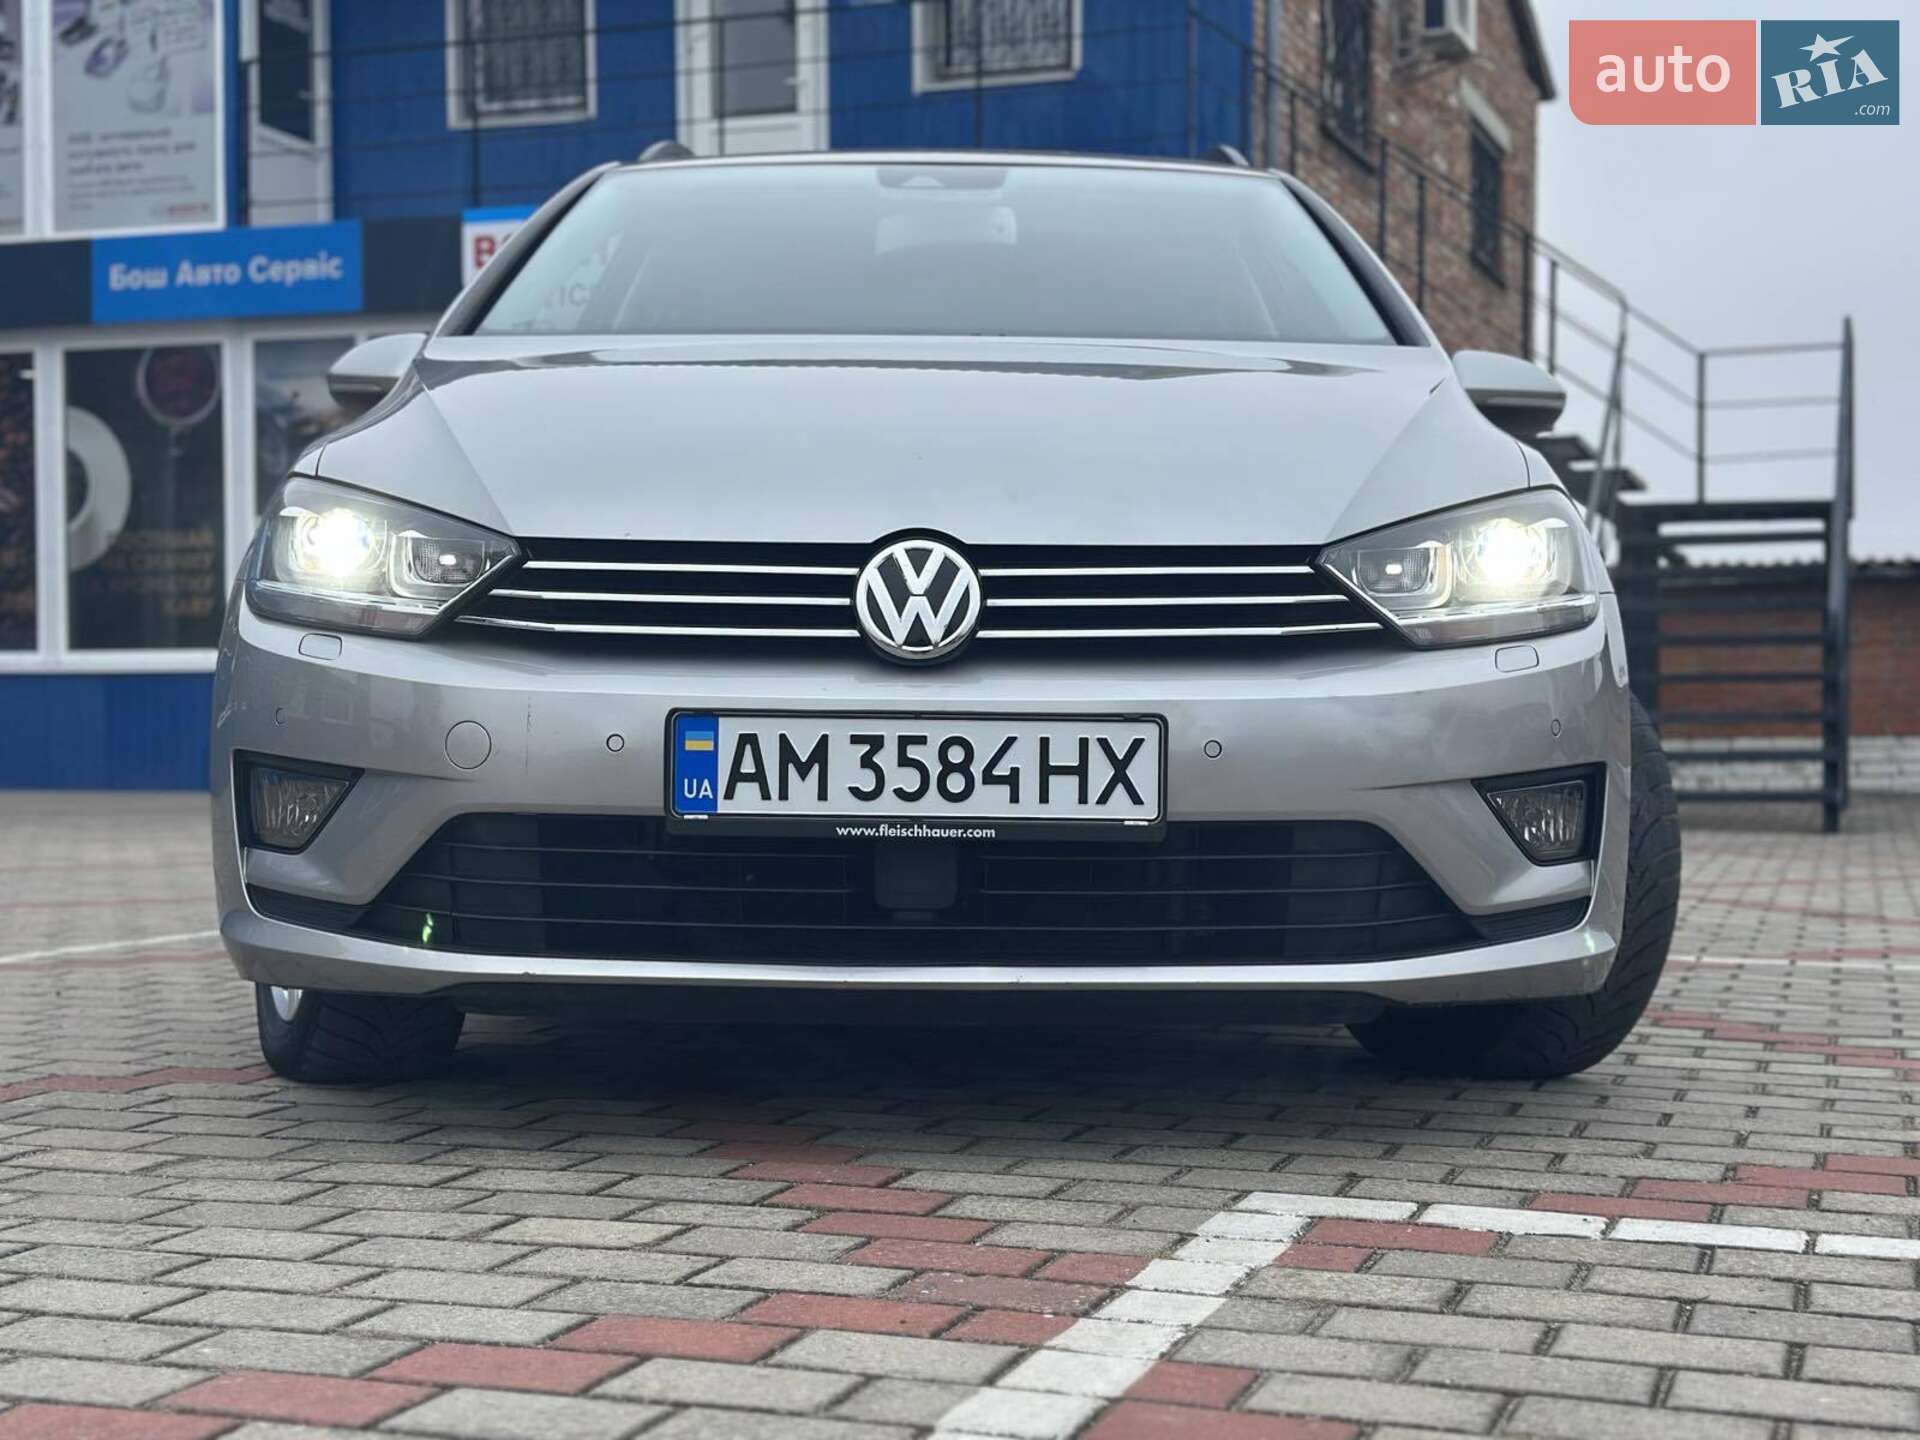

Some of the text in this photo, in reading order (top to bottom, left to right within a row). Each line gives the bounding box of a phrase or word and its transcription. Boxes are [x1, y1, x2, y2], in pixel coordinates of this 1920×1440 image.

[108, 251, 344, 291] Бош Авто Сервіс
[723, 732, 1147, 806] AM 3584 HX
[683, 779, 714, 800] UA
[835, 823, 997, 840] www.fleischhauer.com
